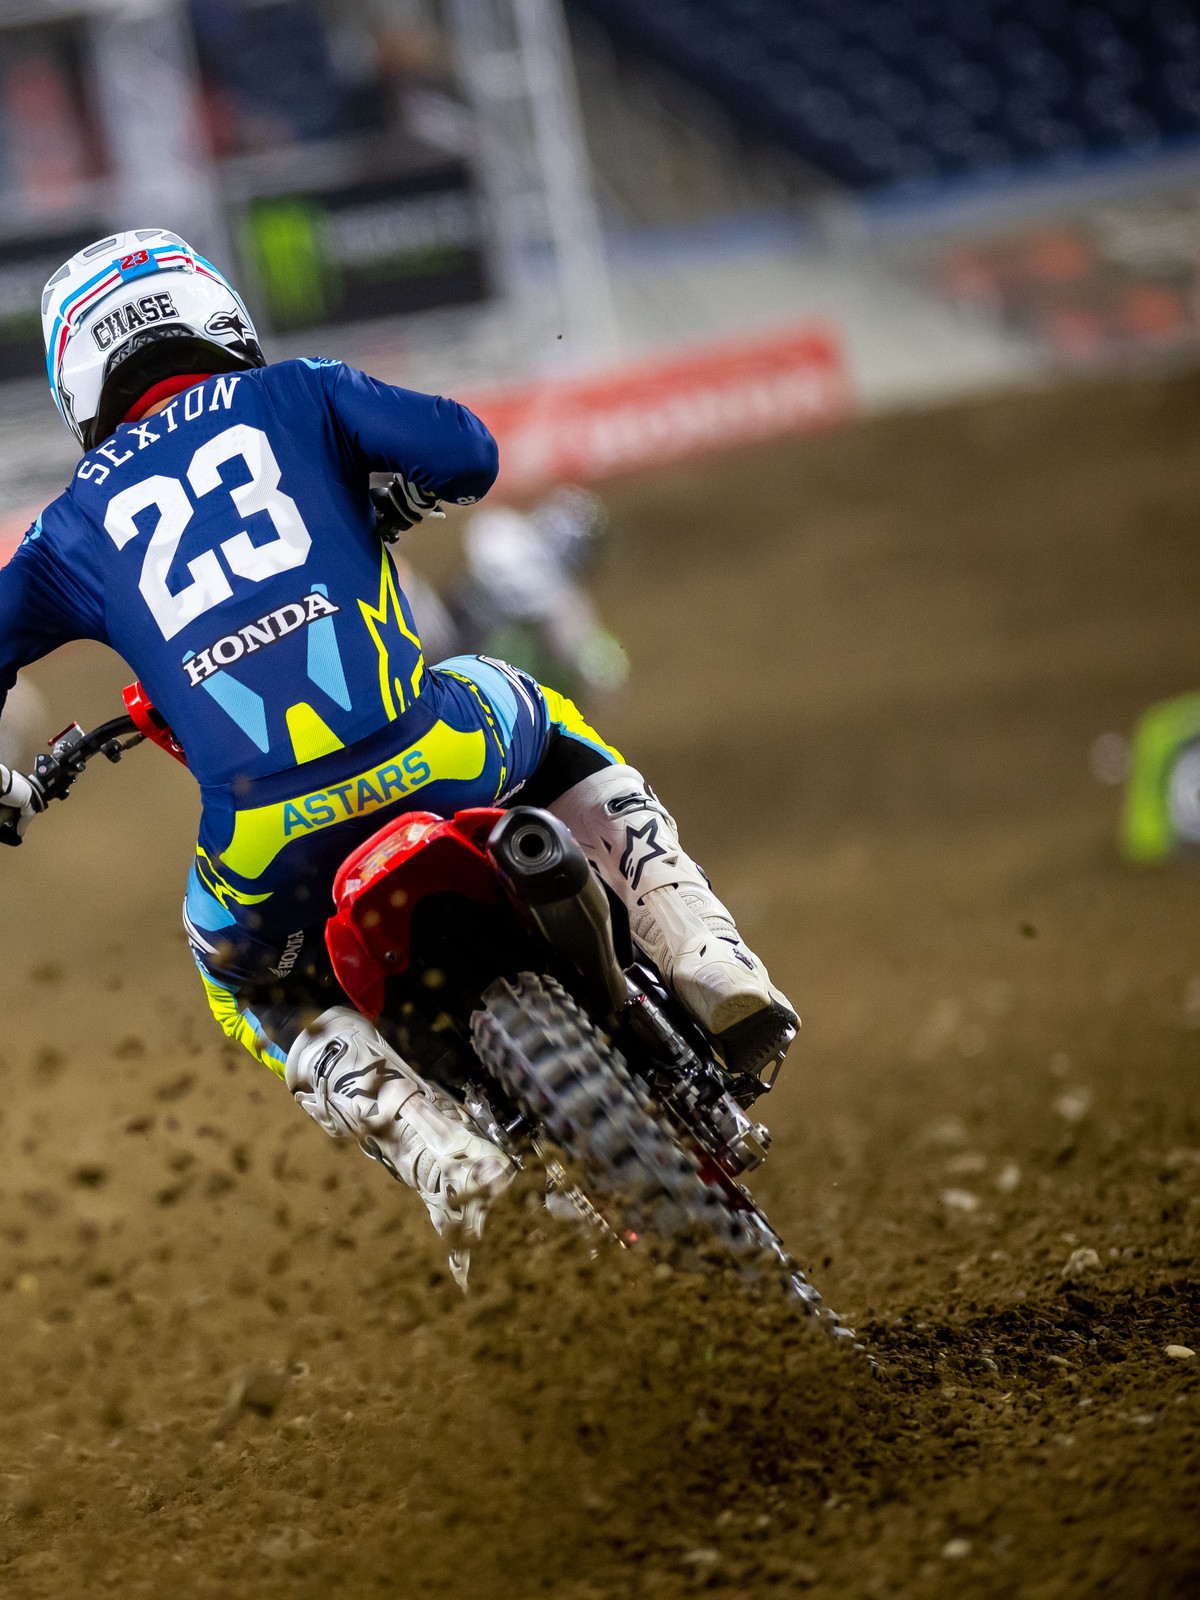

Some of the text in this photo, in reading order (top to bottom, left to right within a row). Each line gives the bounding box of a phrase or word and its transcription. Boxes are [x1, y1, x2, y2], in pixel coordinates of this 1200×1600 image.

[118, 249, 150, 272] 23
[91, 291, 180, 352] CHASE
[77, 376, 242, 487] SEXTON
[103, 422, 313, 643] 23
[182, 592, 341, 689] HONDA
[282, 750, 432, 837] ASTARS
